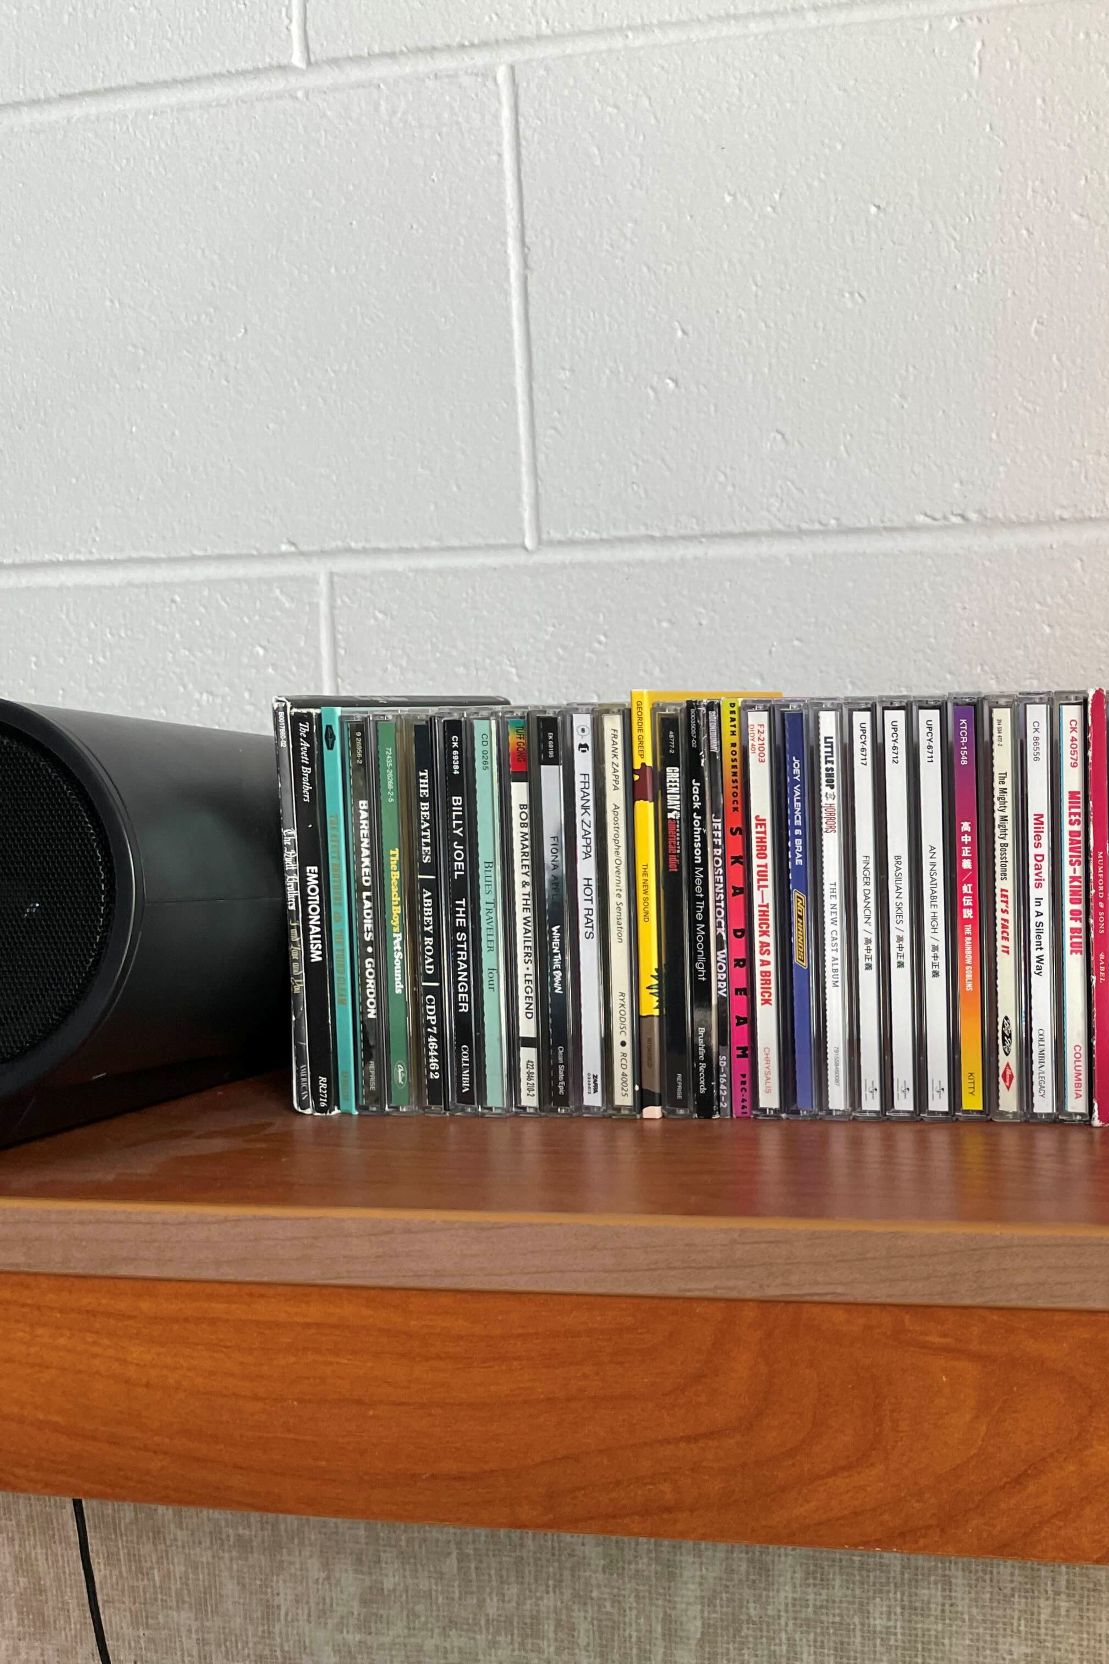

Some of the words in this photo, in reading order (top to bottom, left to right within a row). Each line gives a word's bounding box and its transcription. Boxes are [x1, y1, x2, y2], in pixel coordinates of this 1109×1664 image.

[299, 722, 309, 737] The
[452, 736, 458, 747] CK
[481, 734, 489, 746] CD
[516, 726, 524, 740] TUFF
[1033, 721, 1040, 733] CK
[1070, 720, 1077, 733] CK
[300, 739, 309, 764] Avett
[517, 742, 525, 762] GONG
[757, 724, 765, 762] F2-21003
[1070, 737, 1078, 767] 40579
[419, 770, 429, 797] THE
[666, 767, 679, 793] GREEN
[793, 756, 801, 780] JOEY
[302, 767, 311, 802] Brothers
[580, 773, 590, 816] FRANK
[692, 779, 700, 808] Jack
[452, 796, 463, 836] BILLY
[519, 804, 528, 828] BOB
[667, 795, 679, 810] DAY
[359, 800, 371, 886] BARENAKED
[421, 802, 431, 863] BEATLES
[581, 820, 591, 860] ZAPPA
[693, 813, 702, 863] Johnson
[1034, 814, 1044, 848] Miles
[454, 841, 464, 878] JOEL
[520, 831, 530, 878] MARLEY
[929, 845, 937, 859] AN
[521, 880, 530, 888] &
[695, 867, 703, 897] Meet
[894, 856, 902, 899] BRASILIAN
[929, 862, 938, 908] INSATIABLE
[1034, 854, 1045, 889] Davis
[523, 892, 531, 913] THE
[584, 878, 593, 905] HOT
[1035, 898, 1043, 906] In
[306, 867, 322, 961] EMOTIONALISM
[363, 892, 374, 941] LADIES
[423, 889, 433, 932] ABBEY
[455, 899, 466, 926] THE
[584, 908, 594, 939] RATS
[696, 901, 705, 920] The
[895, 902, 904, 925] SKIES
[523, 916, 533, 964] WAILERS
[695, 924, 706, 981] Moonlight
[897, 935, 905, 968] 高中正義
[1035, 922, 1044, 952] Silent
[425, 938, 434, 974] ROAD
[931, 944, 940, 978] 高中正義
[1034, 955, 1044, 976] Way
[457, 932, 468, 1012] STRANGER
[831, 957, 839, 988] ALBUM
[365, 958, 376, 1018] GORDON
[525, 973, 534, 1020] LEGEND
[698, 1028, 706, 1060] Brushfire
[461, 1045, 470, 1092] COLUMBIA
[1074, 1045, 1082, 1099] COLUMBIA
[319, 1076, 327, 1107] RR2716
